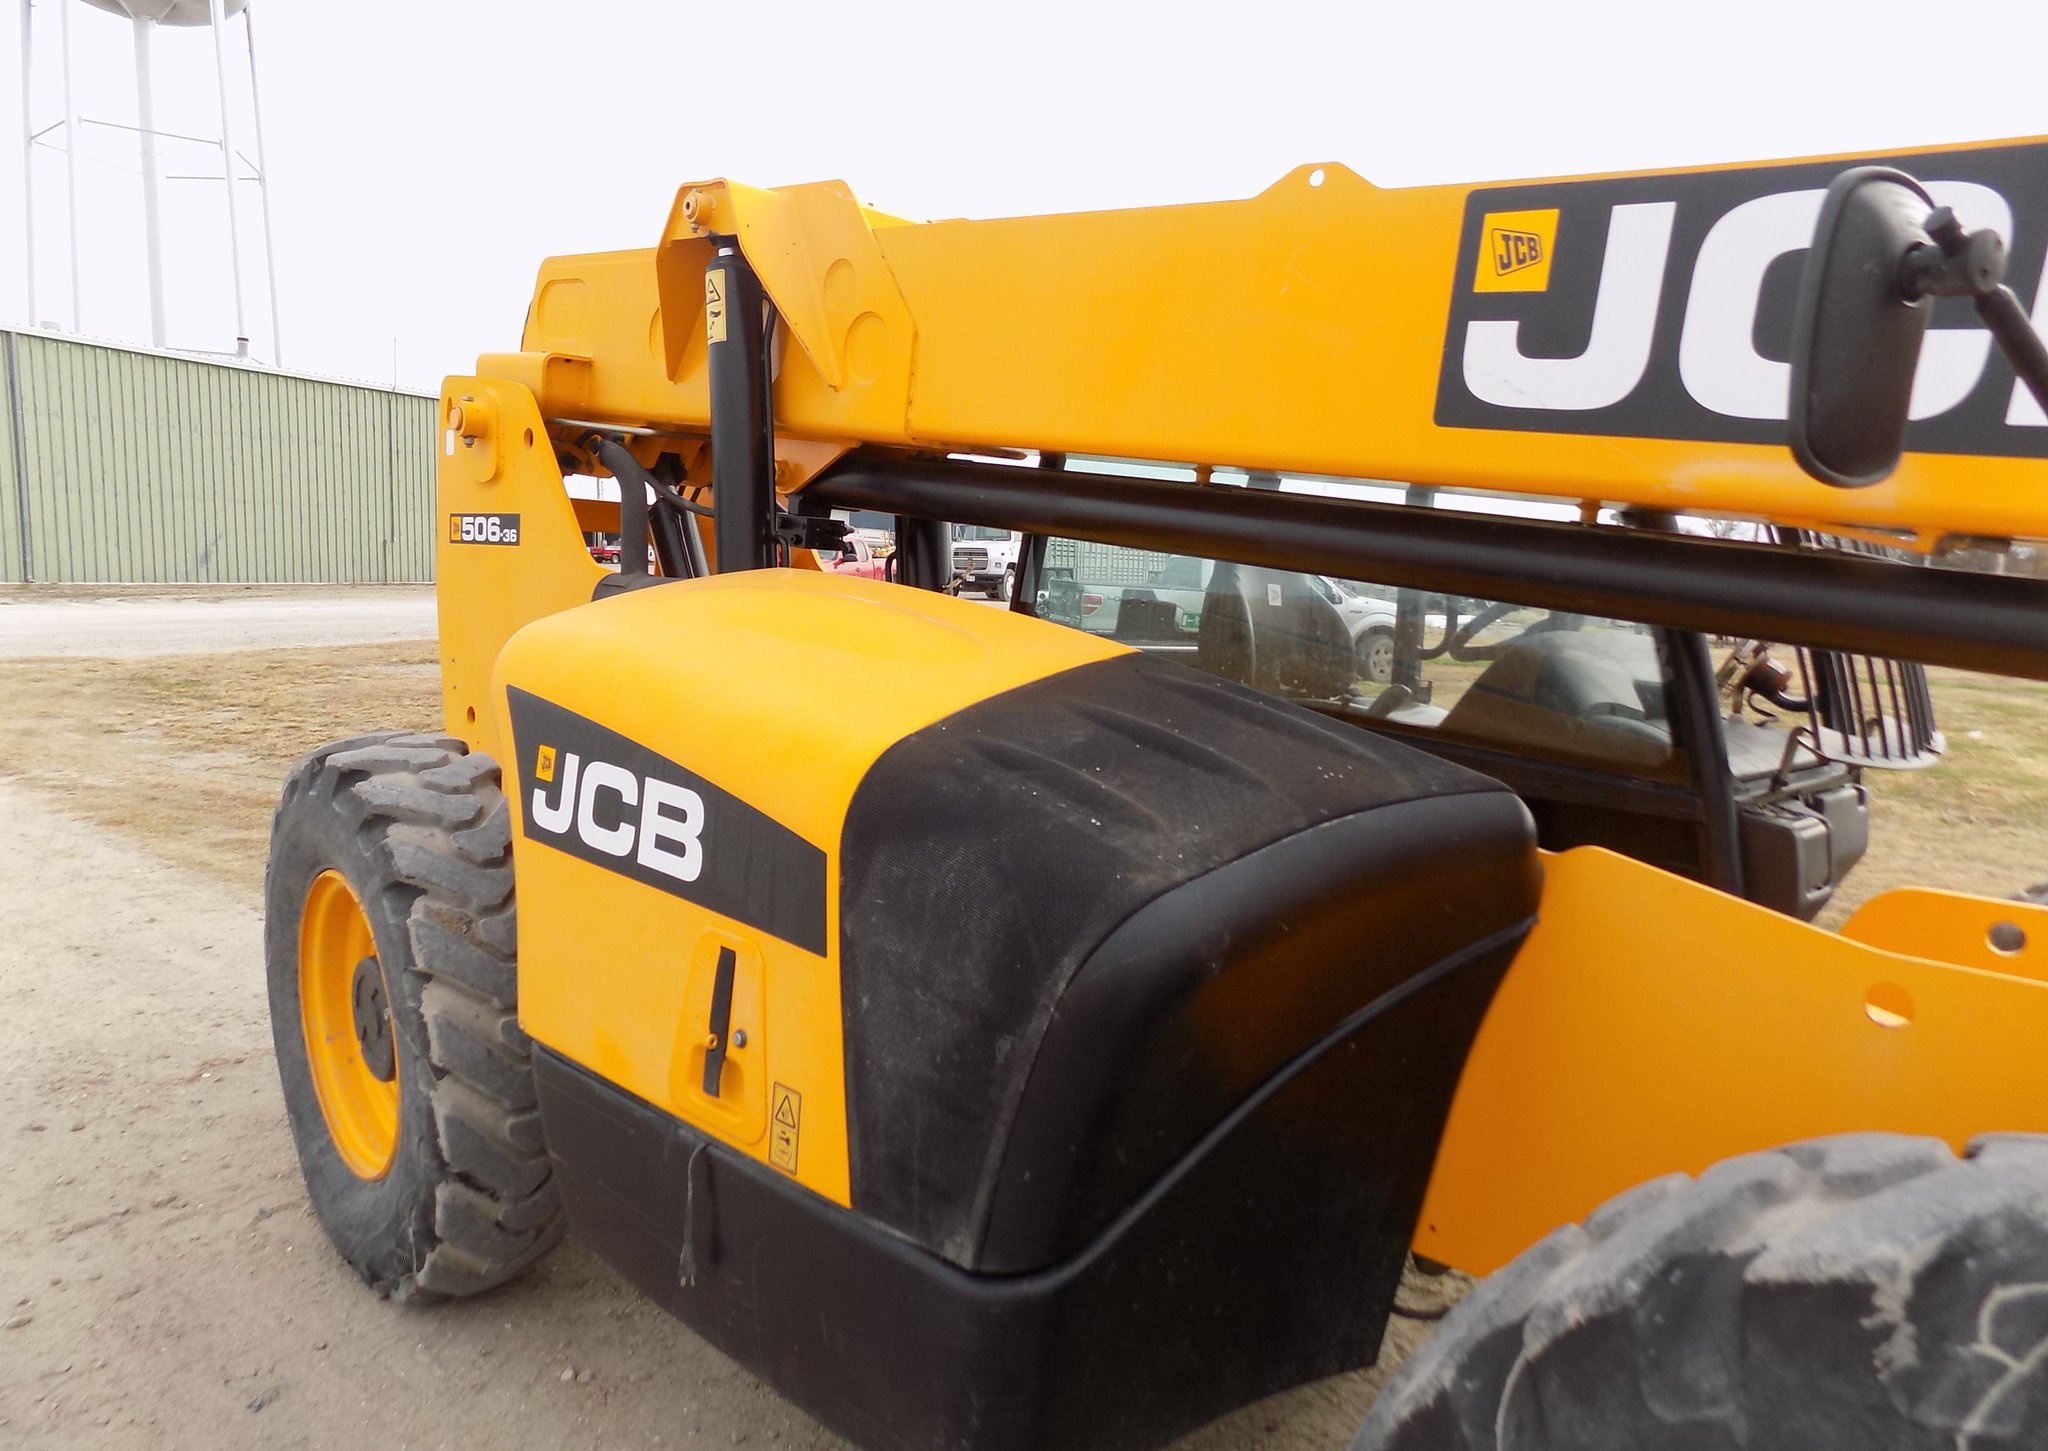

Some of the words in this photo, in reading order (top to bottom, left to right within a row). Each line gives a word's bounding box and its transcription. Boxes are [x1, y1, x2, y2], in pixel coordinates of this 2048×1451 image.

[1463, 180, 2048, 426] JC
[1498, 233, 1539, 271] JCB
[532, 752, 705, 882] JCB
